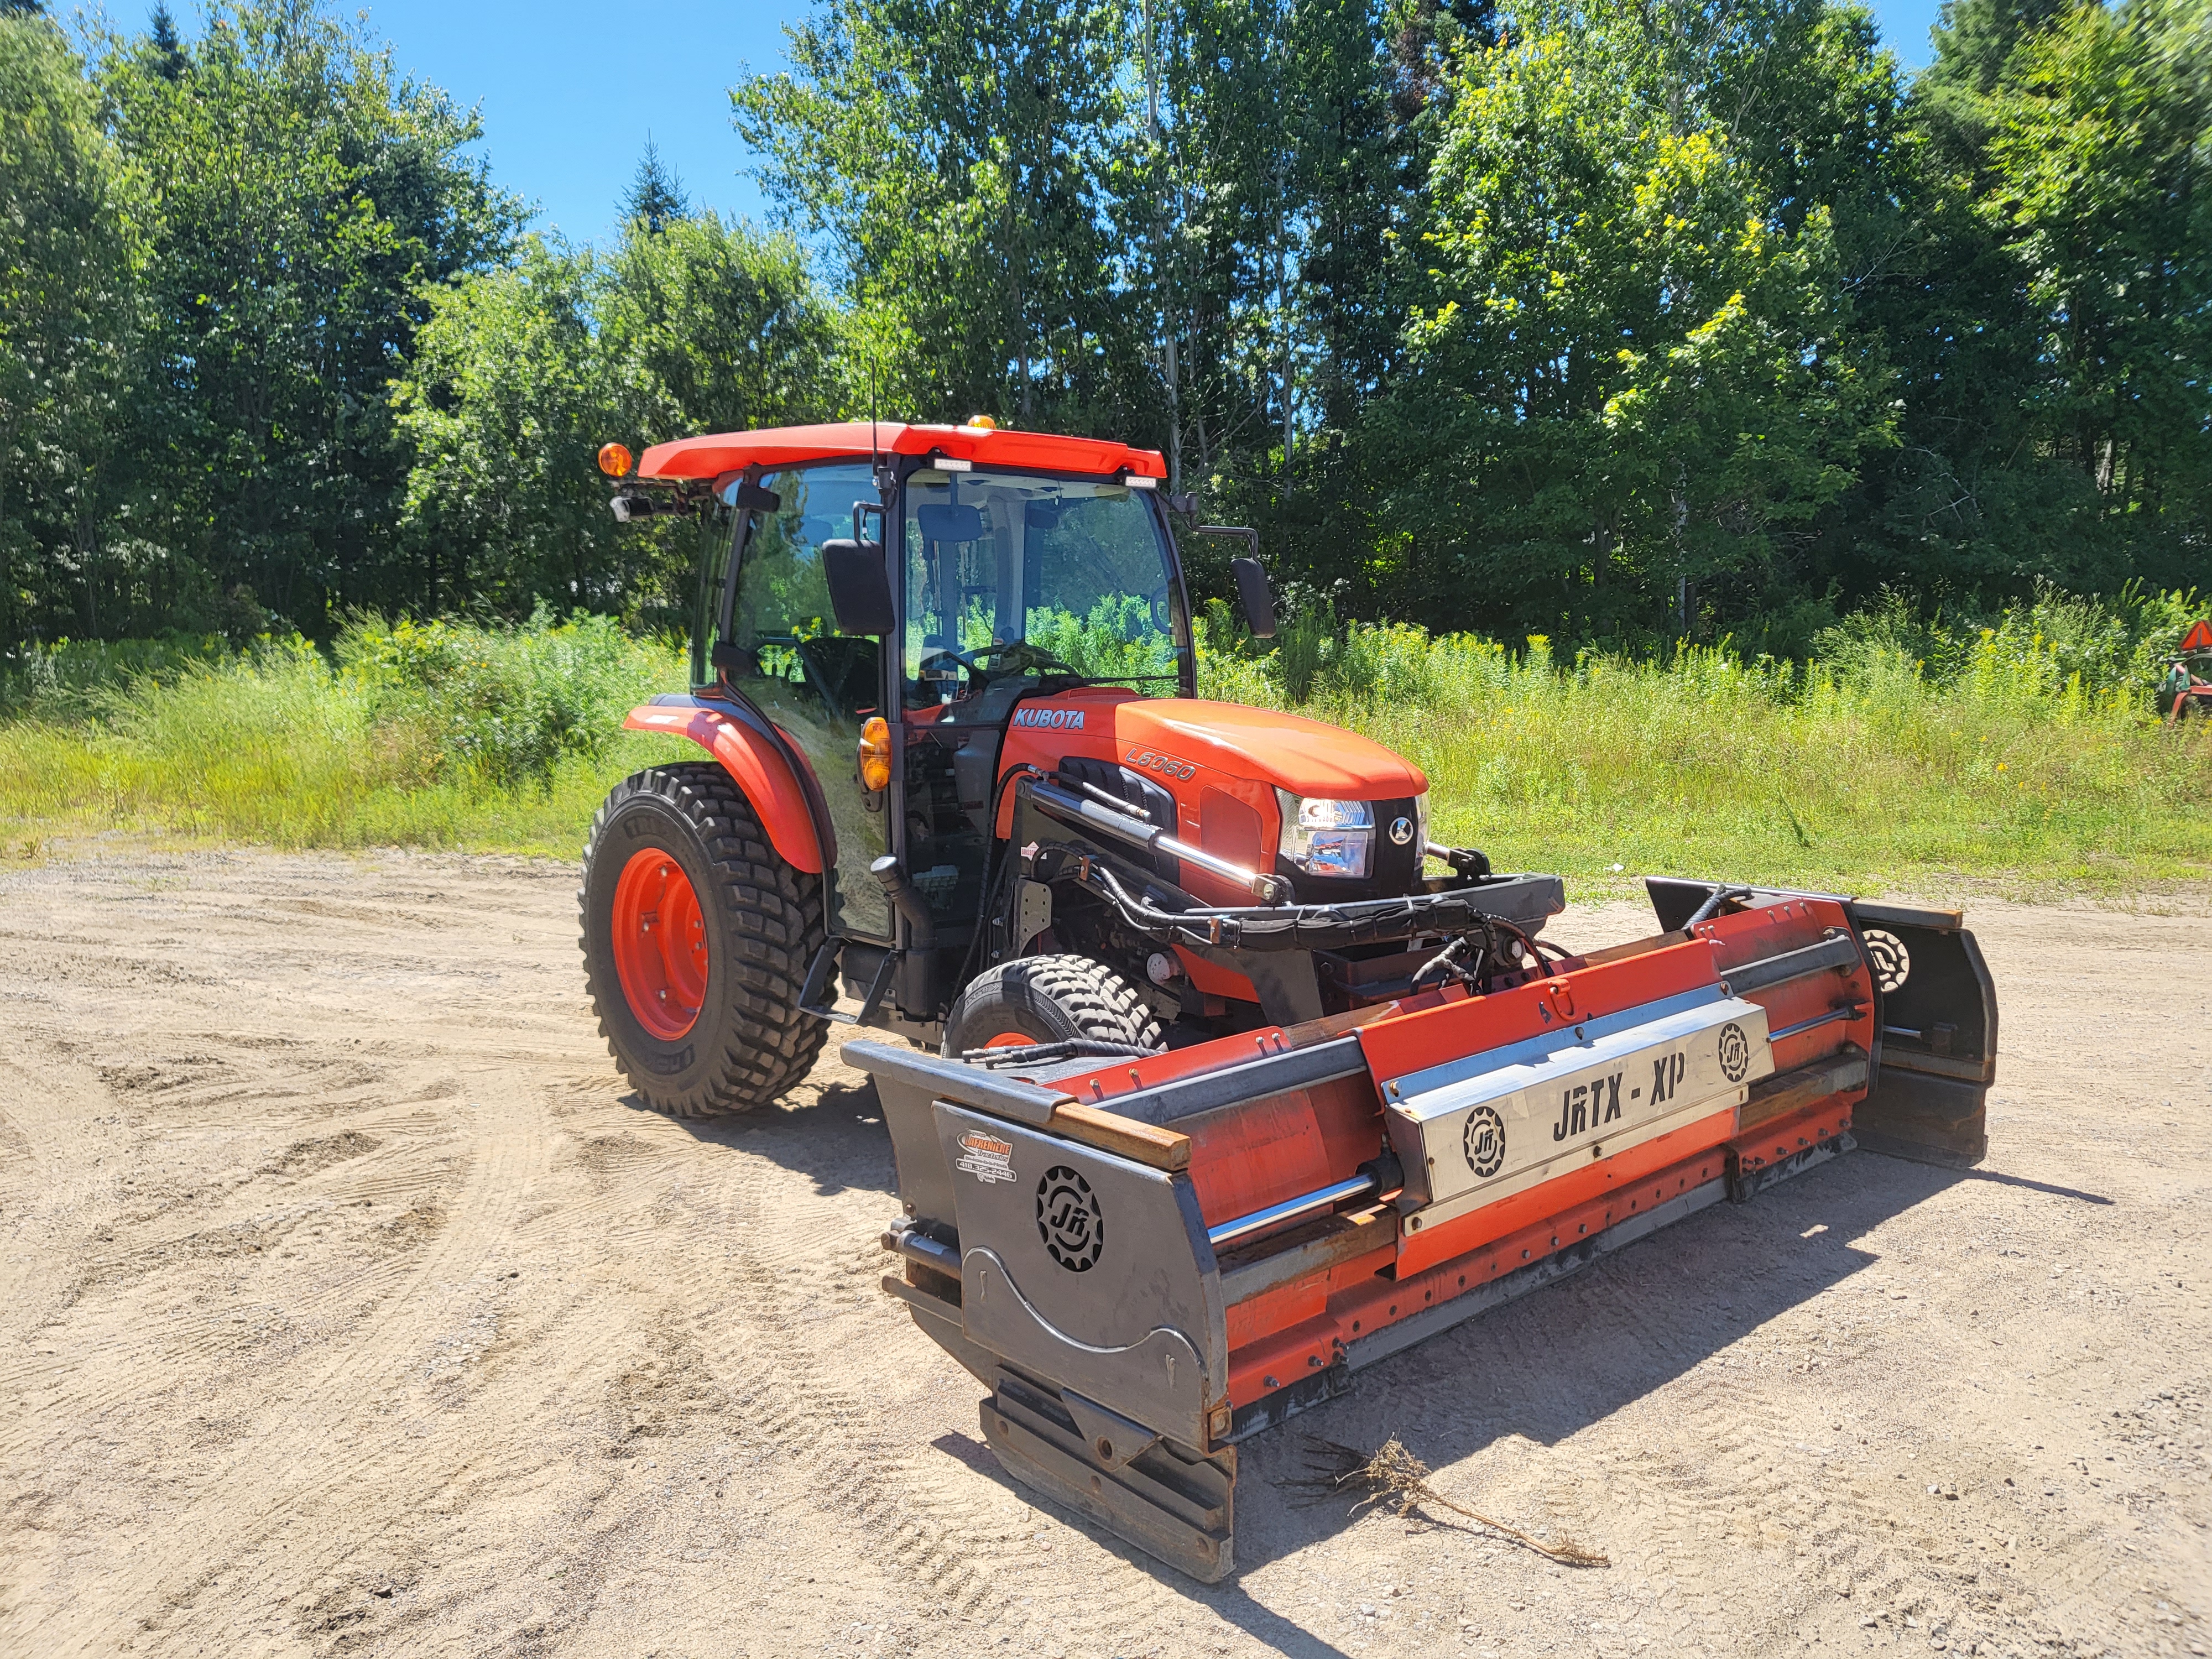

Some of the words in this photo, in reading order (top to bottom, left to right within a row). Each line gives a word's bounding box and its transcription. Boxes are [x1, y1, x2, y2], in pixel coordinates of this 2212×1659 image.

[1013, 708, 1084, 729] KUBOTA
[1125, 748, 1196, 781] L6060
[1727, 1042, 1740, 1063] JR
[1553, 1072, 1623, 1141] JRTX
[1650, 1052, 1684, 1106] XP
[1474, 1128, 1494, 1155] JR
[959, 1162, 1012, 1178] 418.325-2446
[1050, 1203, 1089, 1237] JR
